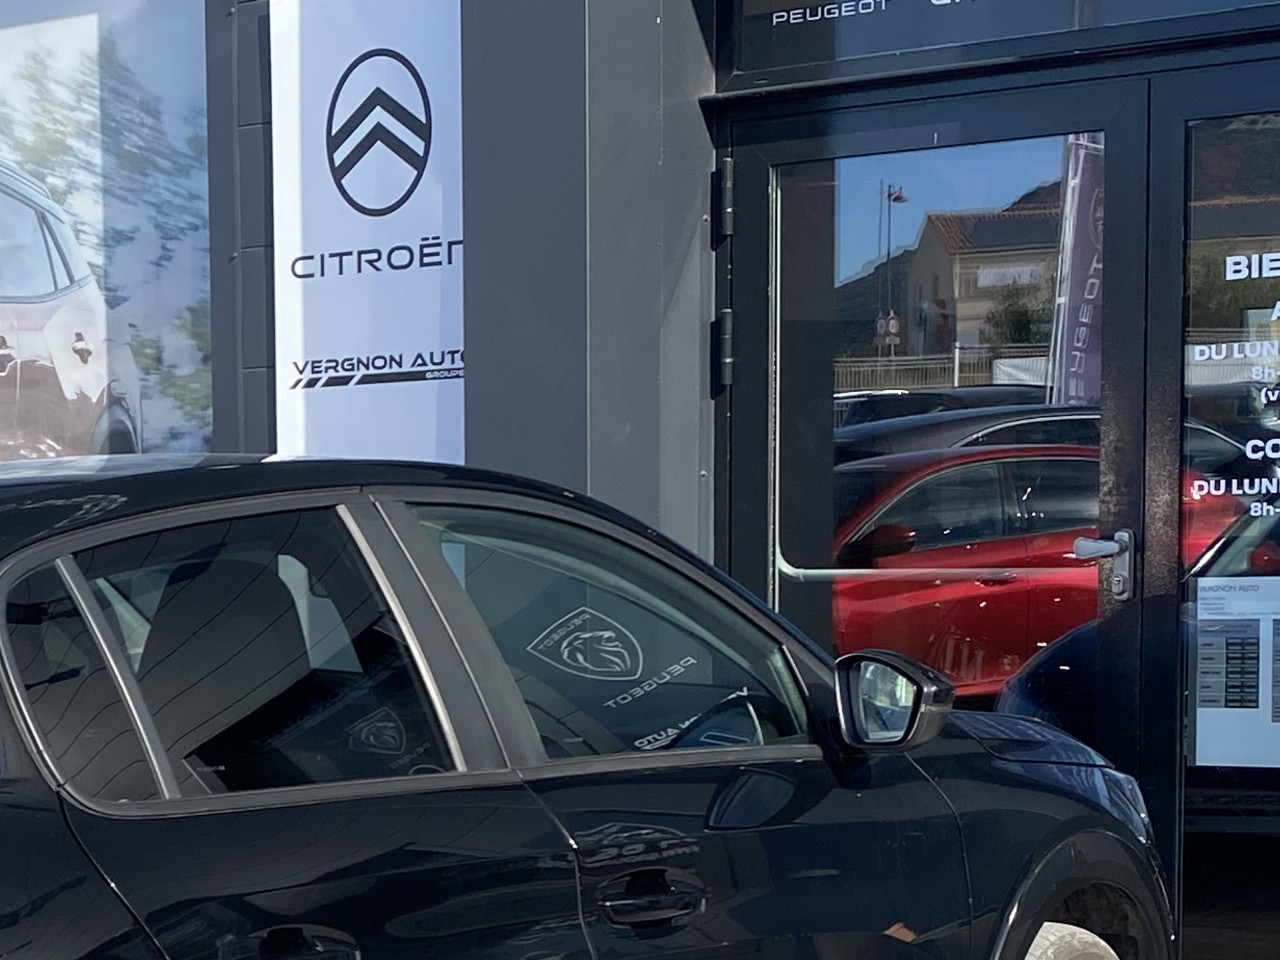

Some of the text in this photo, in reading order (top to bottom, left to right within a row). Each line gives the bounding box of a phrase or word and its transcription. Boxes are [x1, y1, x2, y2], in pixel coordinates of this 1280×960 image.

[1195, 343, 1226, 360] DU
[293, 353, 403, 375] VERGNON
[1194, 480, 1225, 496] DU
